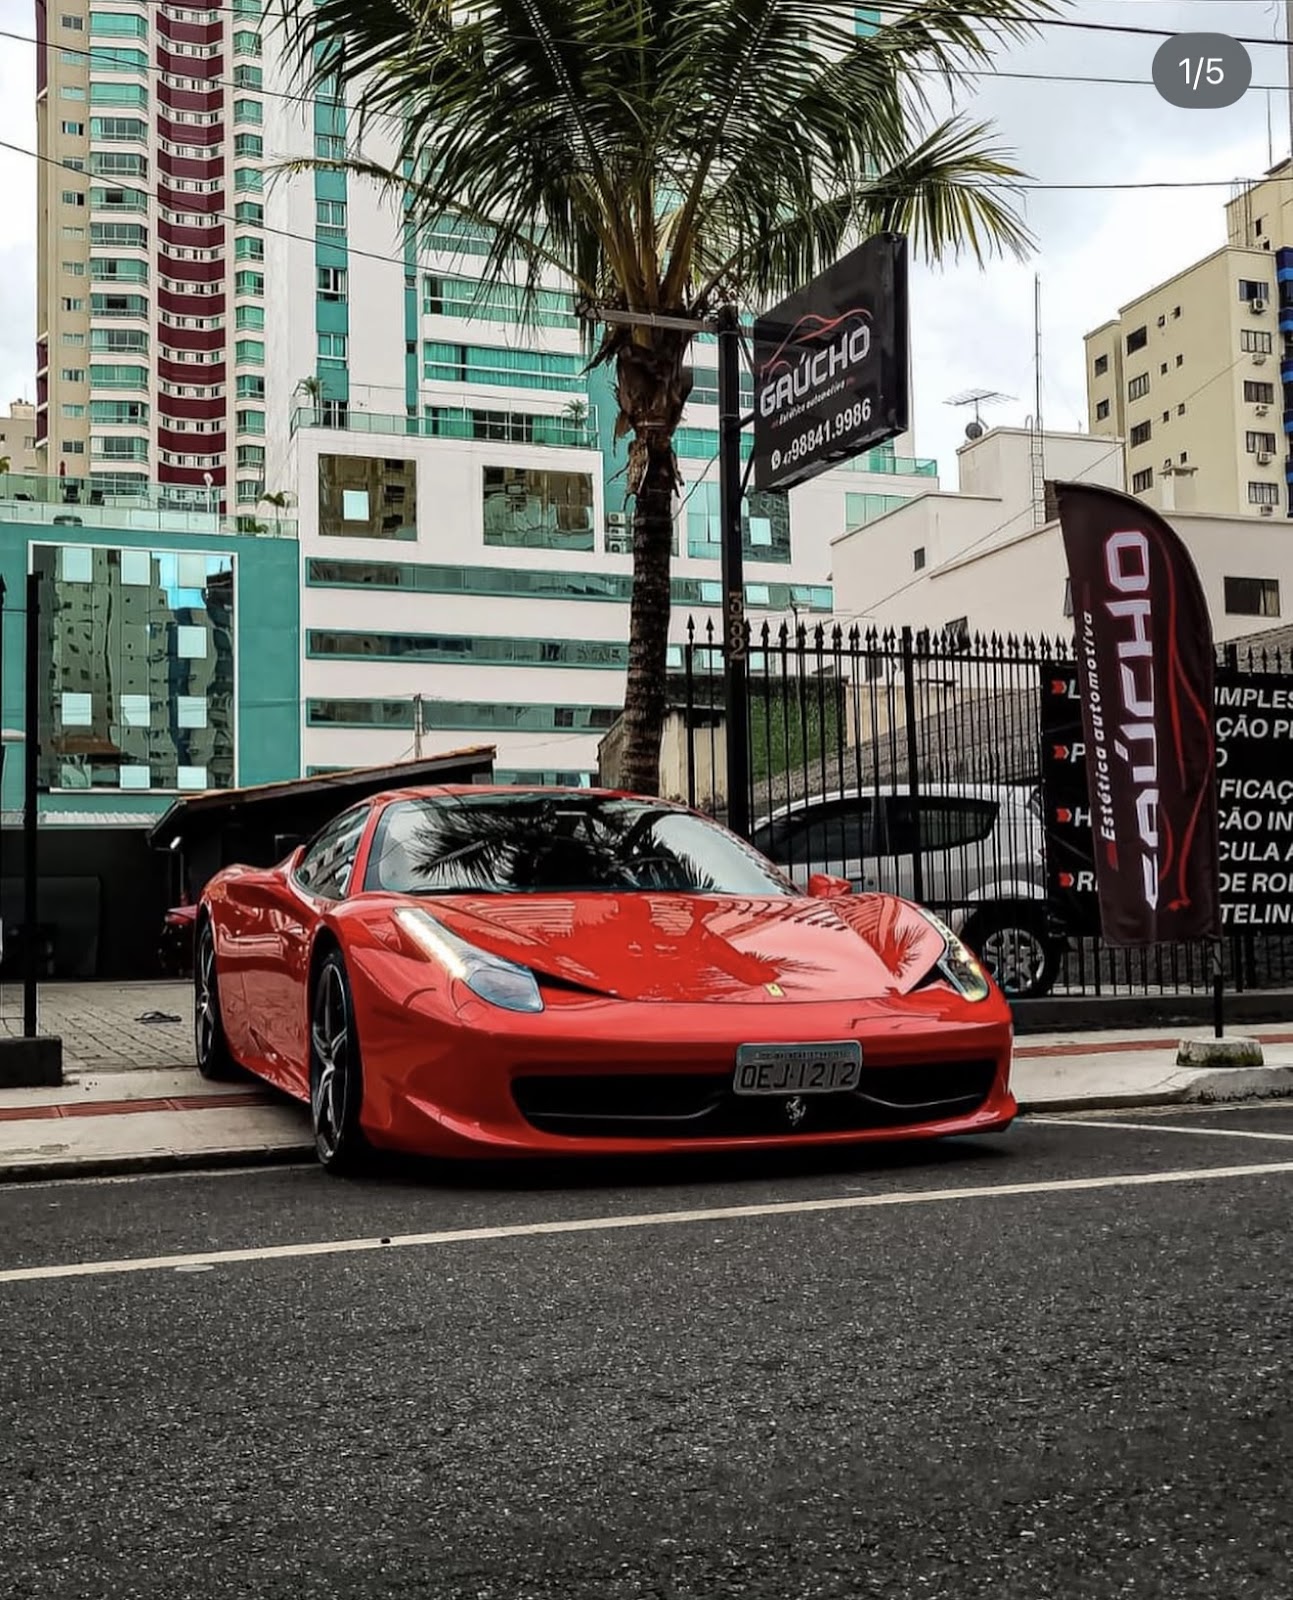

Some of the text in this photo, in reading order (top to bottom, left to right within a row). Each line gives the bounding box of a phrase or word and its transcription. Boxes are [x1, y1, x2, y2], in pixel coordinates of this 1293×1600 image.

[760, 324, 870, 418] GAÚCHO
[1083, 610, 1116, 842] Estética automotiva
[1217, 778, 1293, 805] FICAÇ
